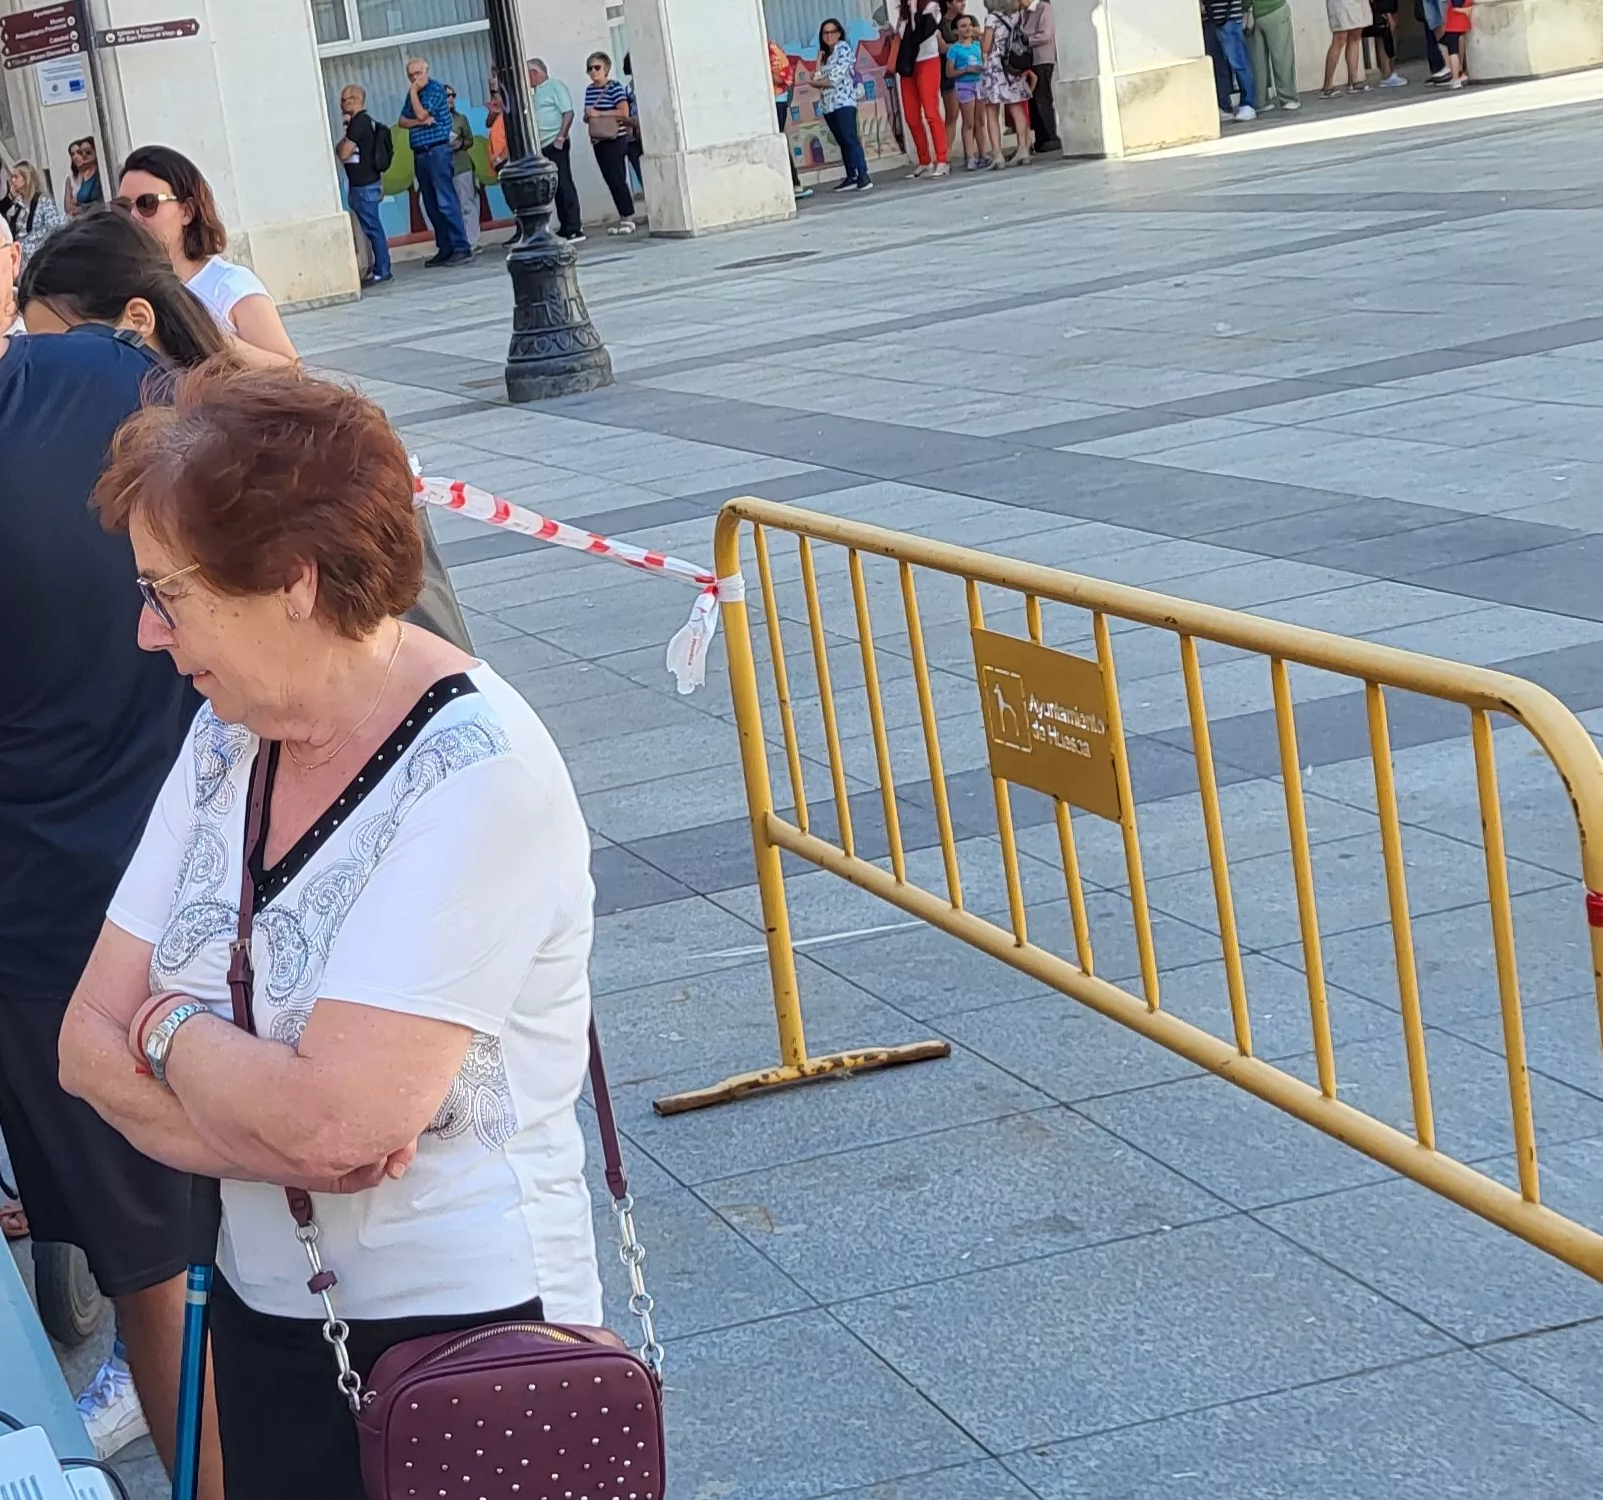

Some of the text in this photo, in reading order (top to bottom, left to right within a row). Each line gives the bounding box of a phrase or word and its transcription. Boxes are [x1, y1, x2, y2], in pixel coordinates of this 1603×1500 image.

[1029, 693, 1105, 735] Ayuntamiento
[1032, 720, 1091, 758] de Huesca
